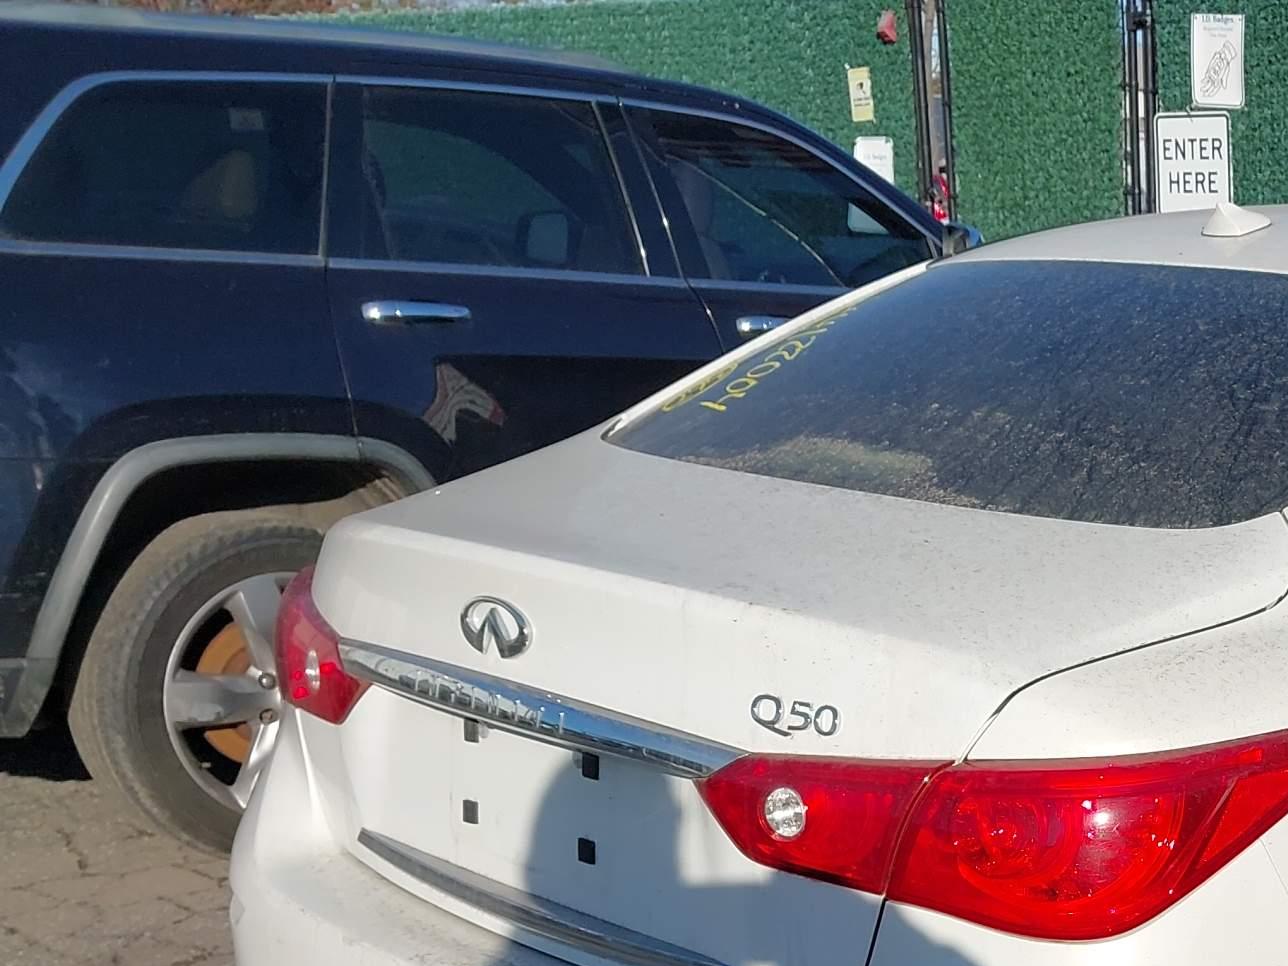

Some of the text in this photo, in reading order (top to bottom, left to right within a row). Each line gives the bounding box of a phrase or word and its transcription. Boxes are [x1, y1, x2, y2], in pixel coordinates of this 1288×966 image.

[1162, 138, 1223, 160] ENTER
[1168, 171, 1219, 193] HERE
[750, 693, 839, 738] Q50
